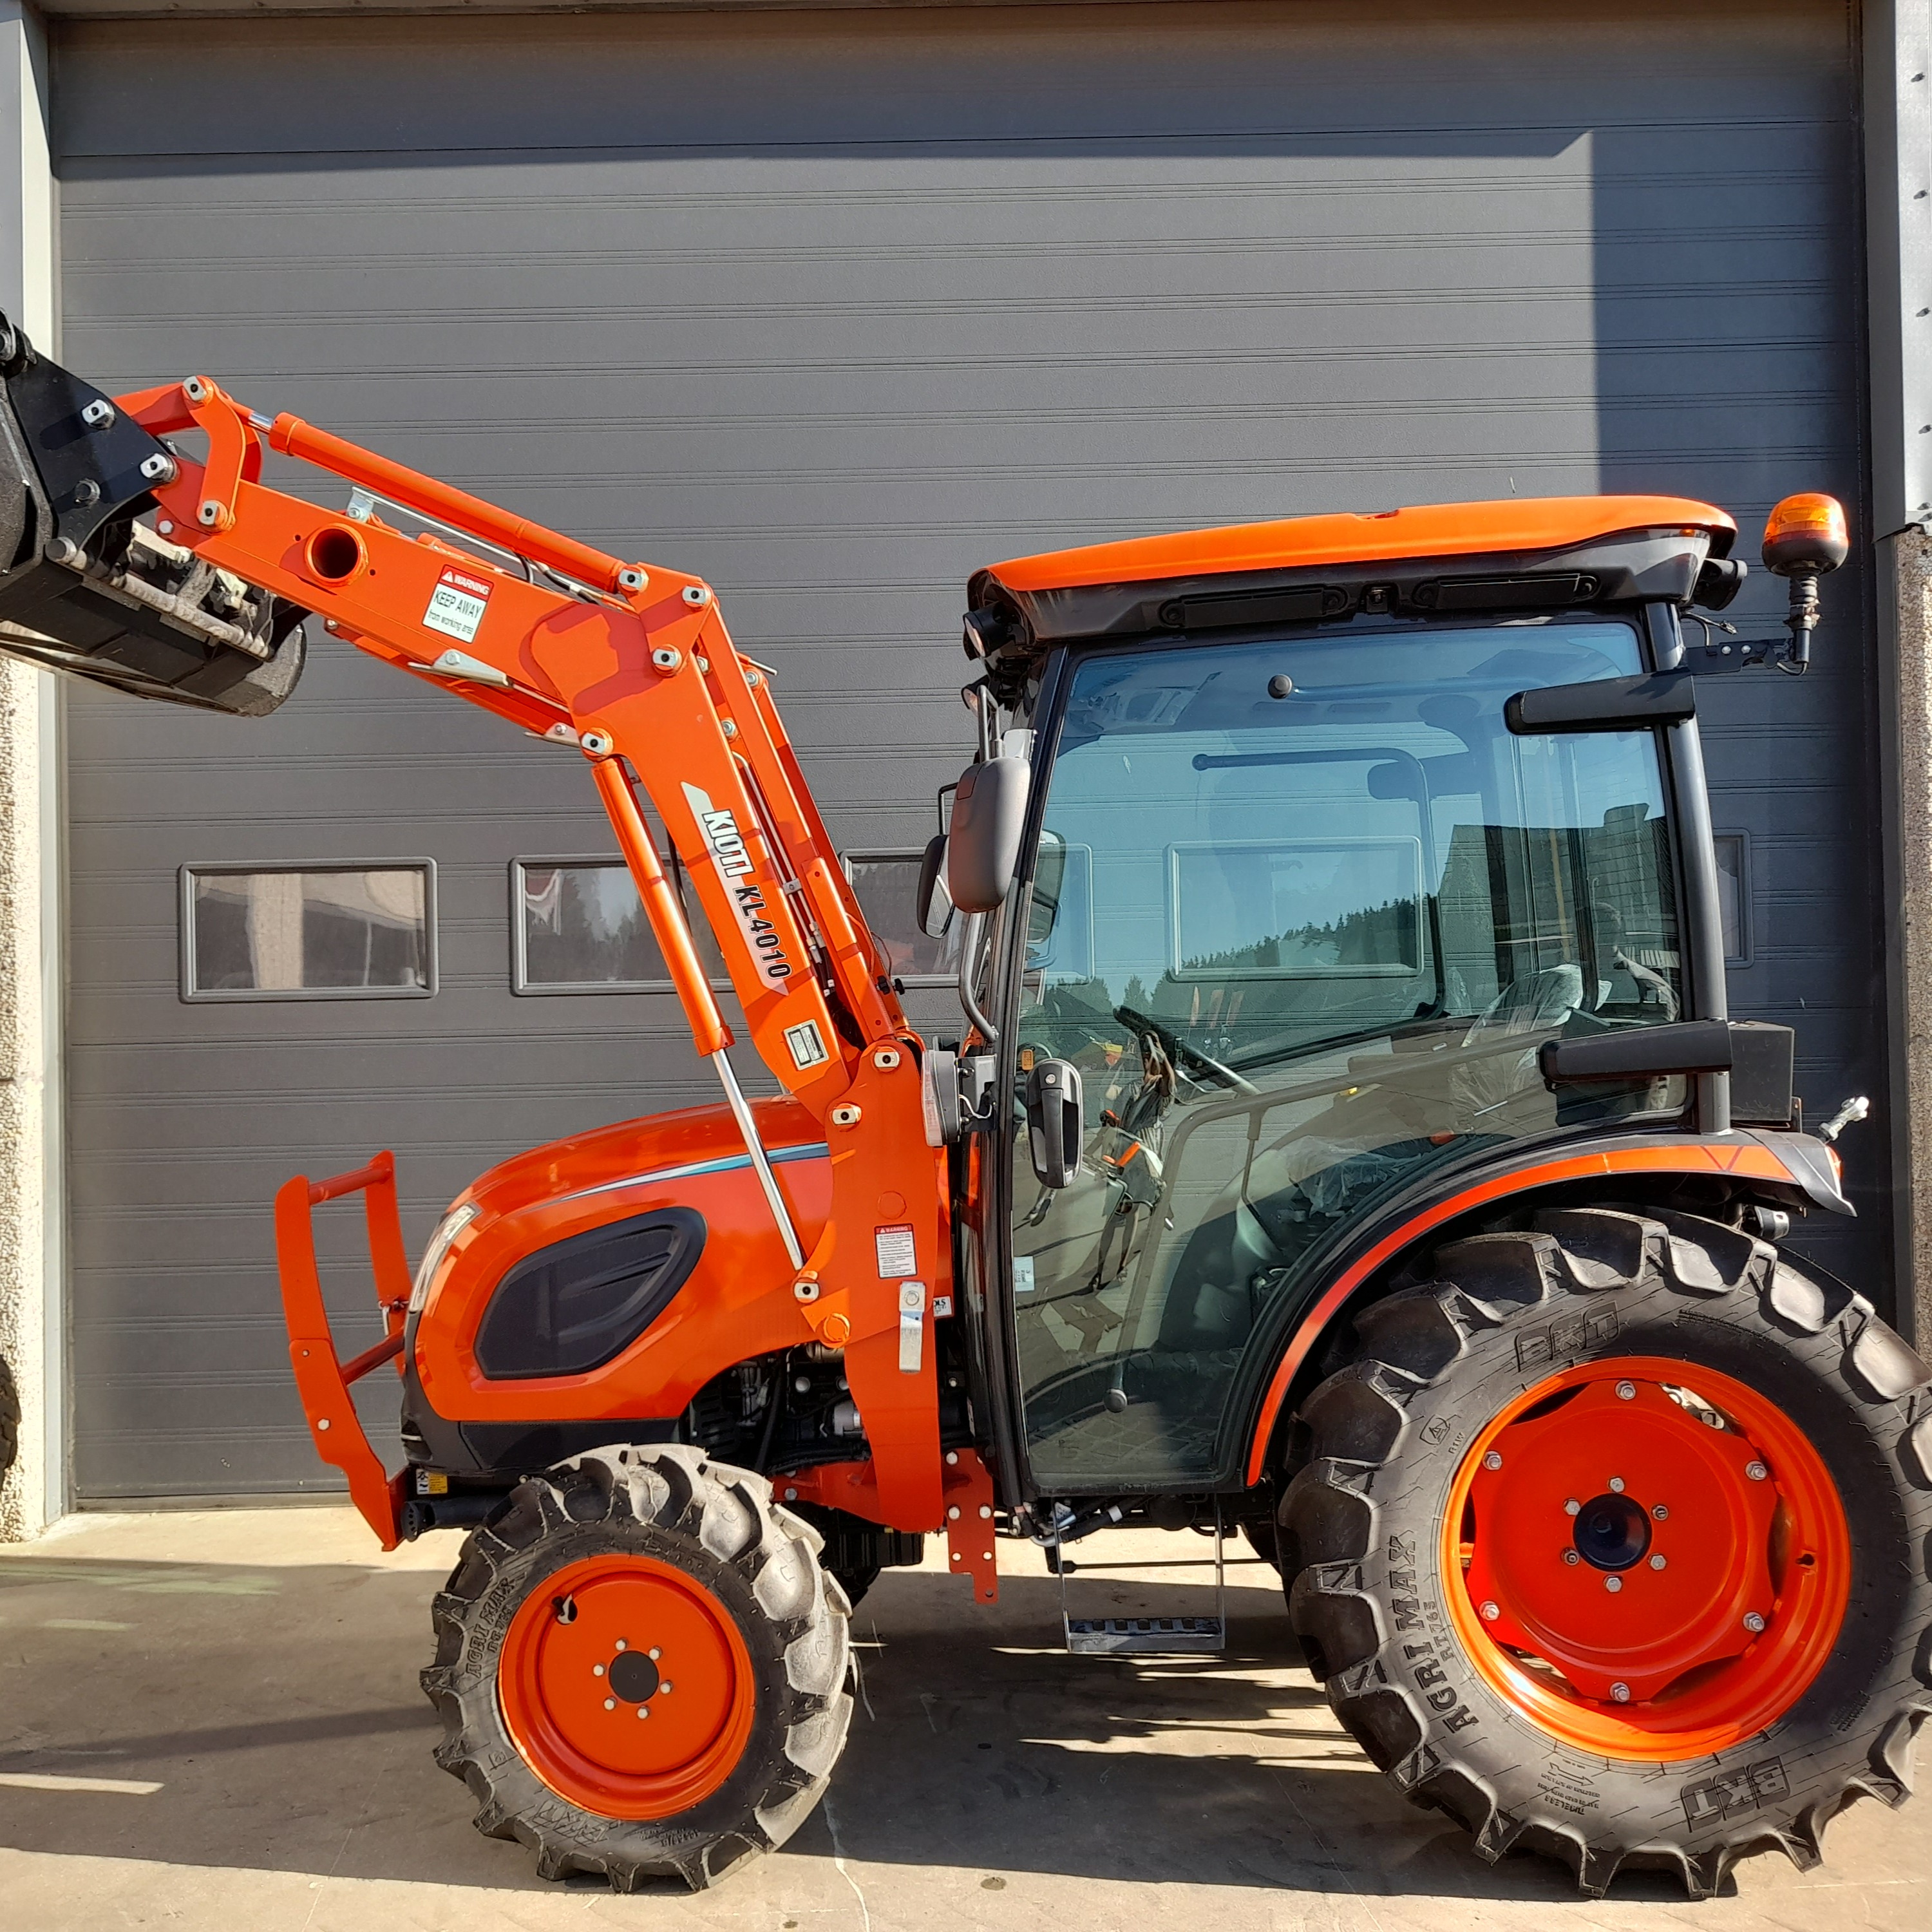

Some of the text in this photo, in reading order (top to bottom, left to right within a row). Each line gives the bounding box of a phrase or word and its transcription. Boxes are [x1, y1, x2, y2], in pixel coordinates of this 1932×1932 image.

[433, 590, 482, 618] KEEP AWAY
[454, 574, 489, 596] WARNING
[701, 809, 754, 878] KIOTI
[466, 1578, 515, 1679] AGRI MAX
[1388, 1534, 1480, 1734] AGRI MAX
[1683, 1759, 1790, 1829] BKT
